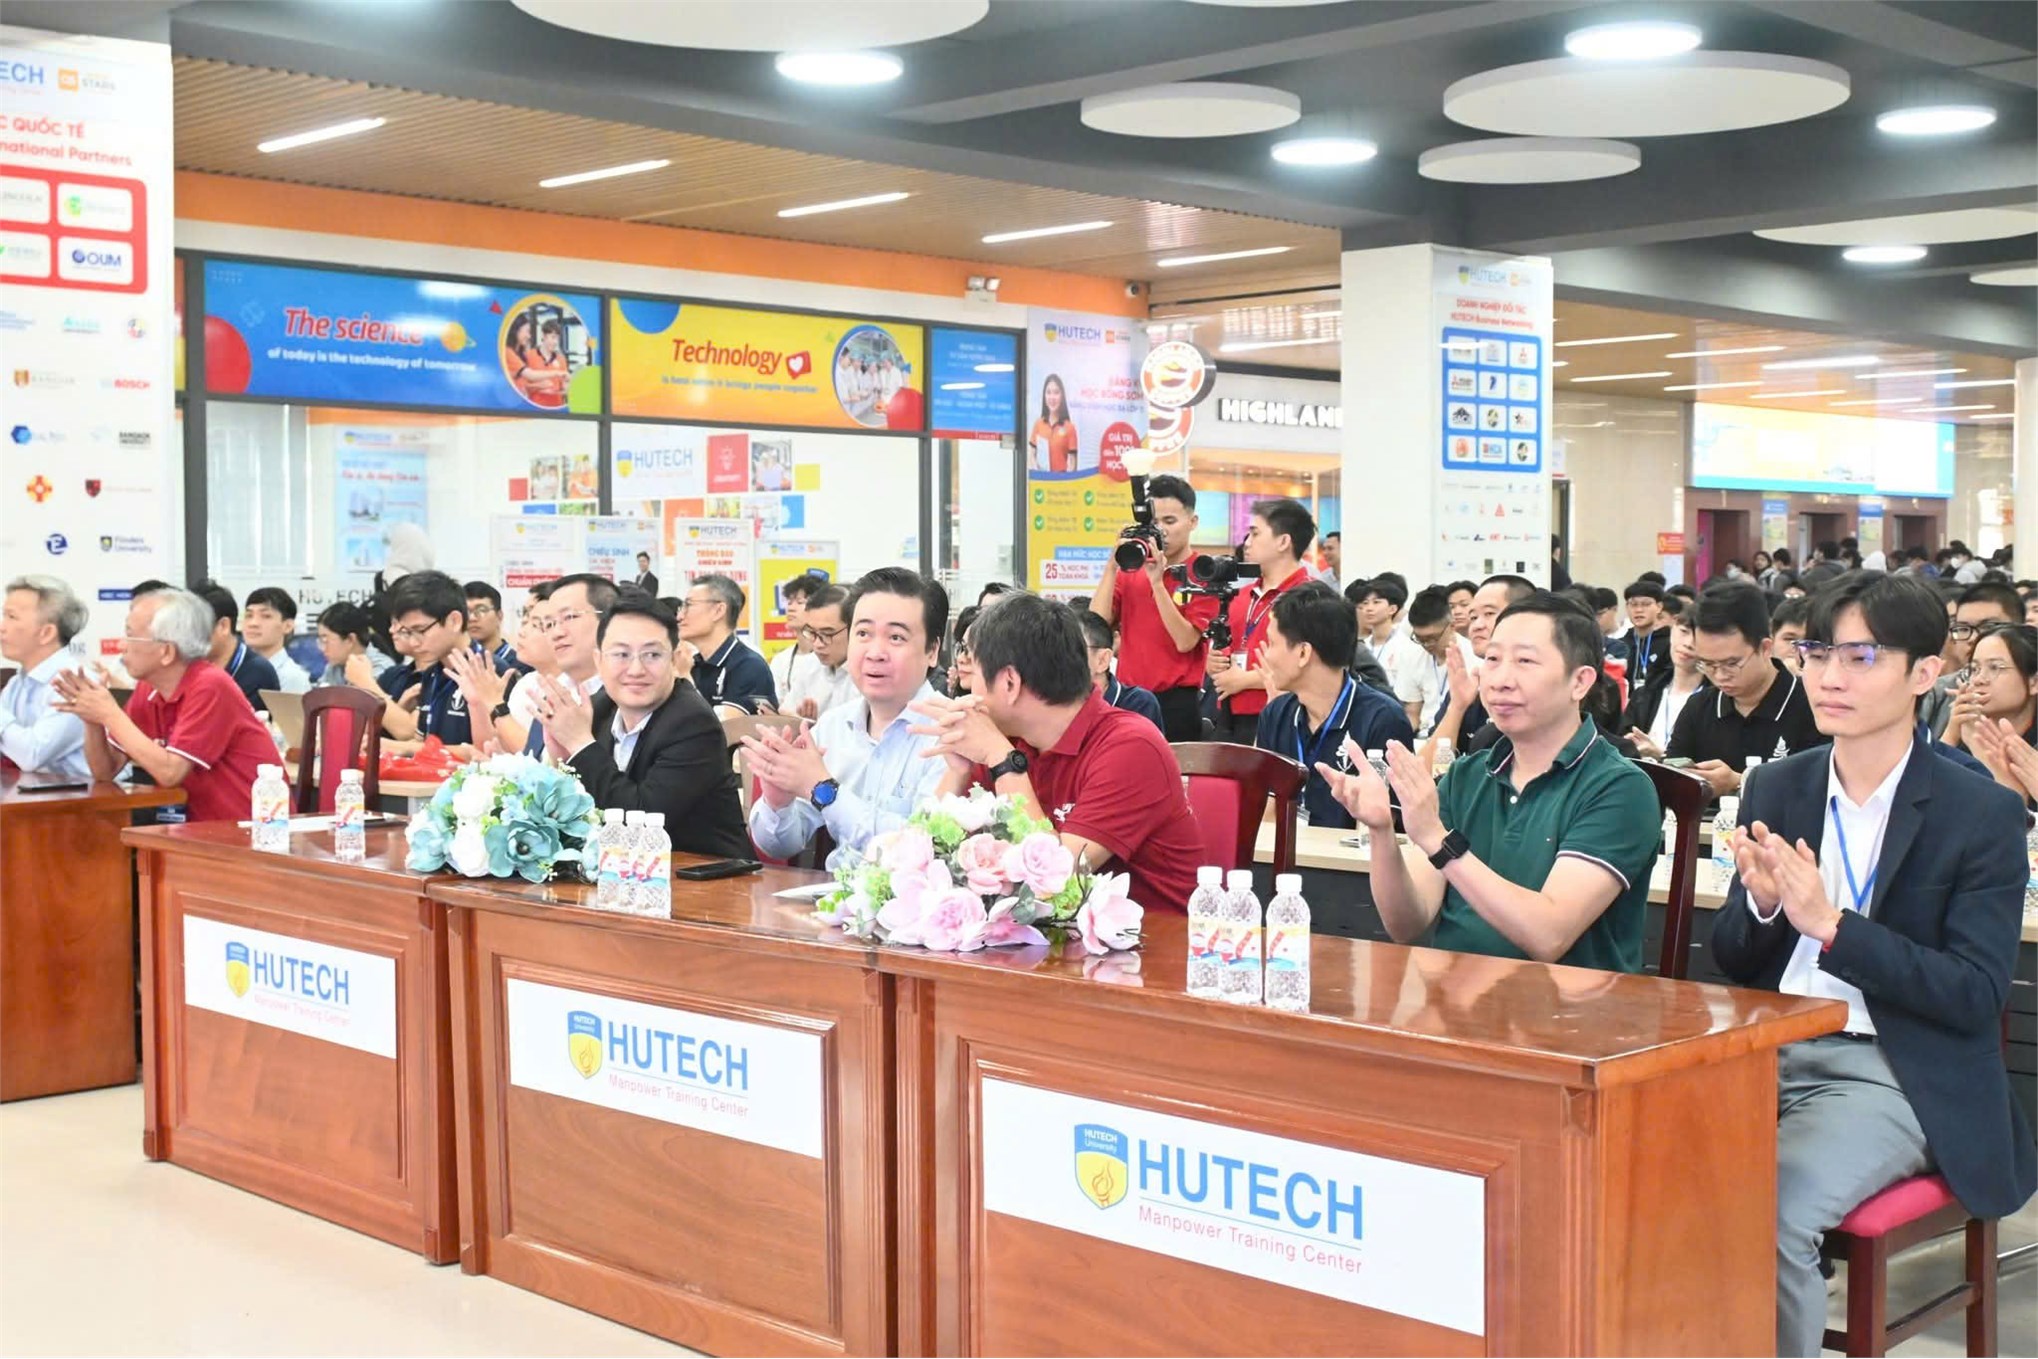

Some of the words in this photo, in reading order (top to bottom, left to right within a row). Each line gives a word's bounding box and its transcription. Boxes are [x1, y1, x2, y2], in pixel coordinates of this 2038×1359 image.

[69, 146, 132, 166] Partners
[87, 252, 121, 267] OUM
[285, 308, 331, 338] The
[335, 312, 424, 345] science
[1058, 326, 1101, 340] HUTECH
[268, 348, 281, 358] of
[283, 349, 315, 362] today
[317, 351, 327, 361] is
[329, 352, 348, 363] the
[349, 354, 409, 369] technology
[411, 357, 423, 368] of
[424, 359, 477, 371] tomorrow
[672, 338, 782, 375] Technology
[115, 379, 150, 390] BOSCH
[634, 448, 693, 469] HUTECH
[701, 525, 737, 536] HUTECH
[115, 545, 152, 554] University
[1046, 563, 1057, 579] 25
[254, 950, 349, 1005] HUTECH
[574, 1015, 596, 1026] HUTECH
[609, 1021, 749, 1090] HUTECH
[609, 1073, 662, 1097] Manpower
[666, 1086, 708, 1111] Training
[711, 1097, 749, 1118] Center
[1084, 1128, 1117, 1143] HUTECH
[1084, 1138, 1117, 1154] University
[1139, 1138, 1363, 1240] HUTECH
[1139, 1205, 1222, 1239] Manpower
[1229, 1225, 1297, 1262] Training
[1303, 1244, 1363, 1275] Center
